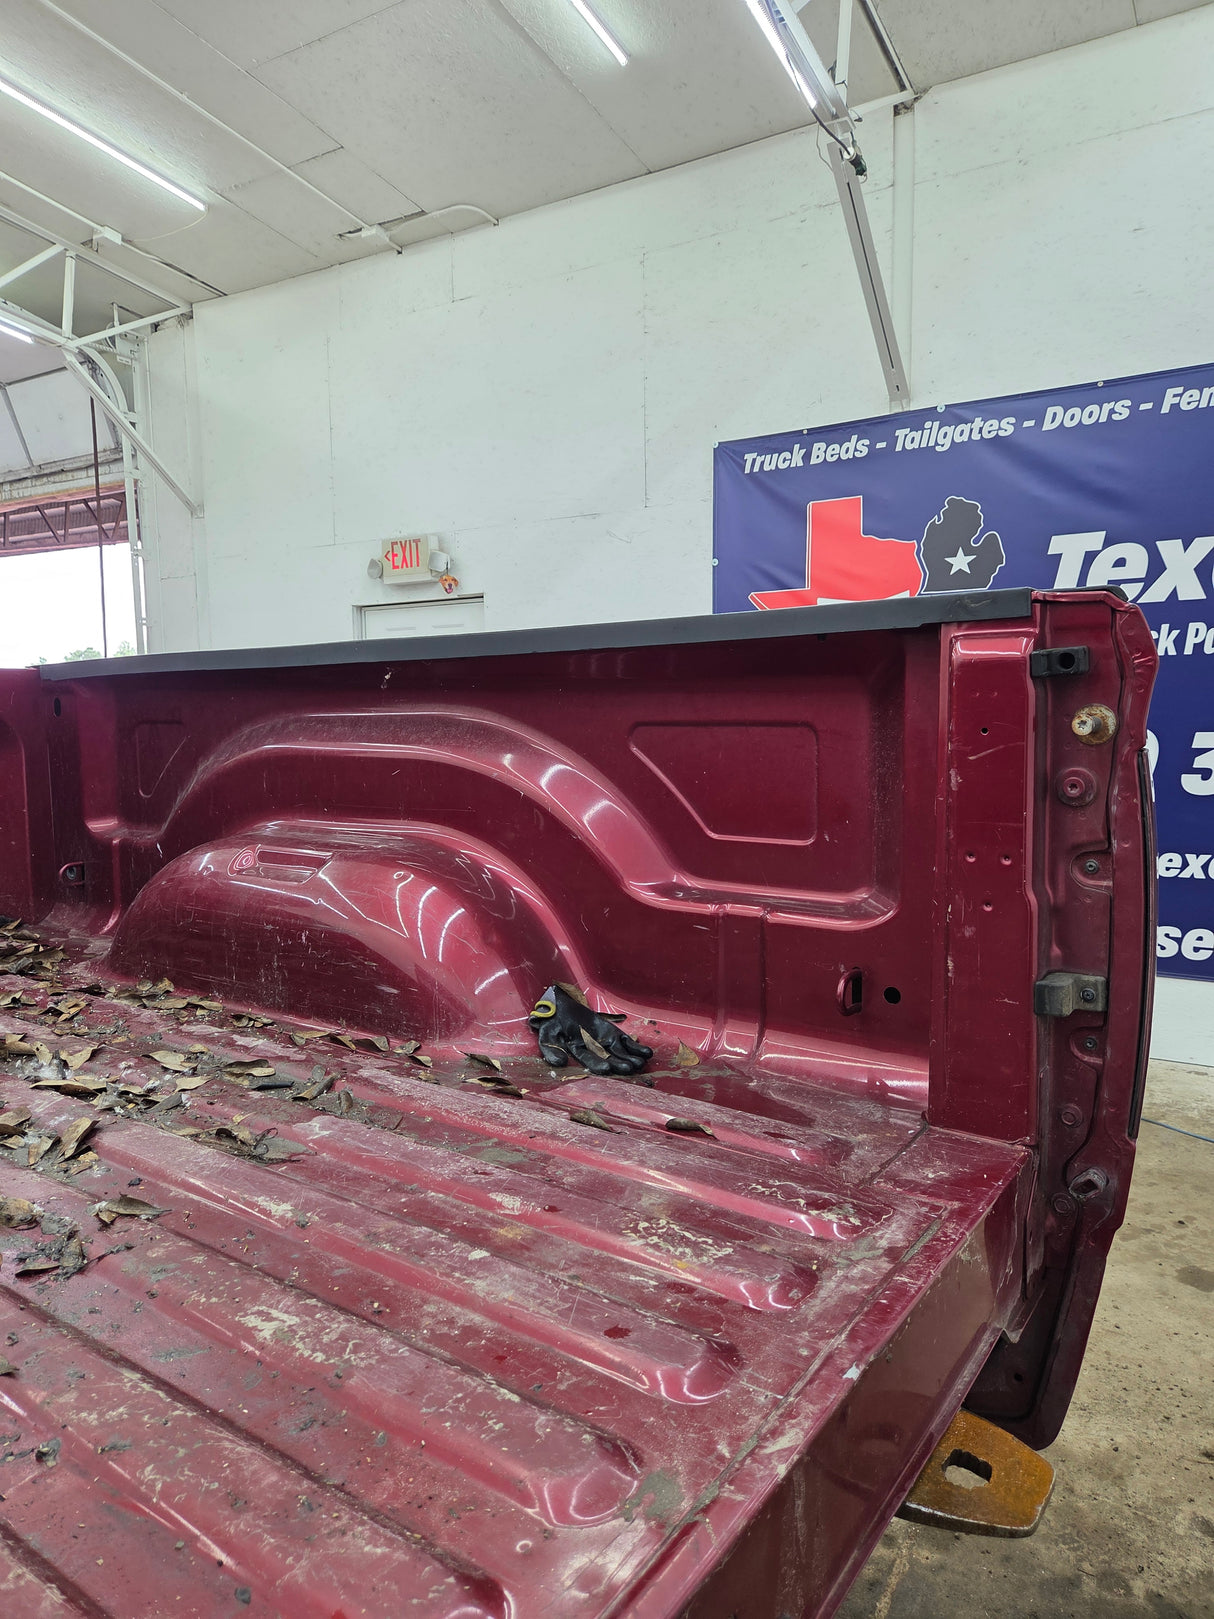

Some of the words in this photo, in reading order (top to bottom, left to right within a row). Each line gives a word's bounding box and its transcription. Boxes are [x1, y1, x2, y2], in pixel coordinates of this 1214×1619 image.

[743, 444, 806, 474] Truck
[809, 434, 871, 465] Beds
[894, 415, 1016, 452] Tailgates
[1041, 399, 1132, 431] Doors
[391, 538, 421, 570] EXIT
[1047, 530, 1214, 604] Tex
